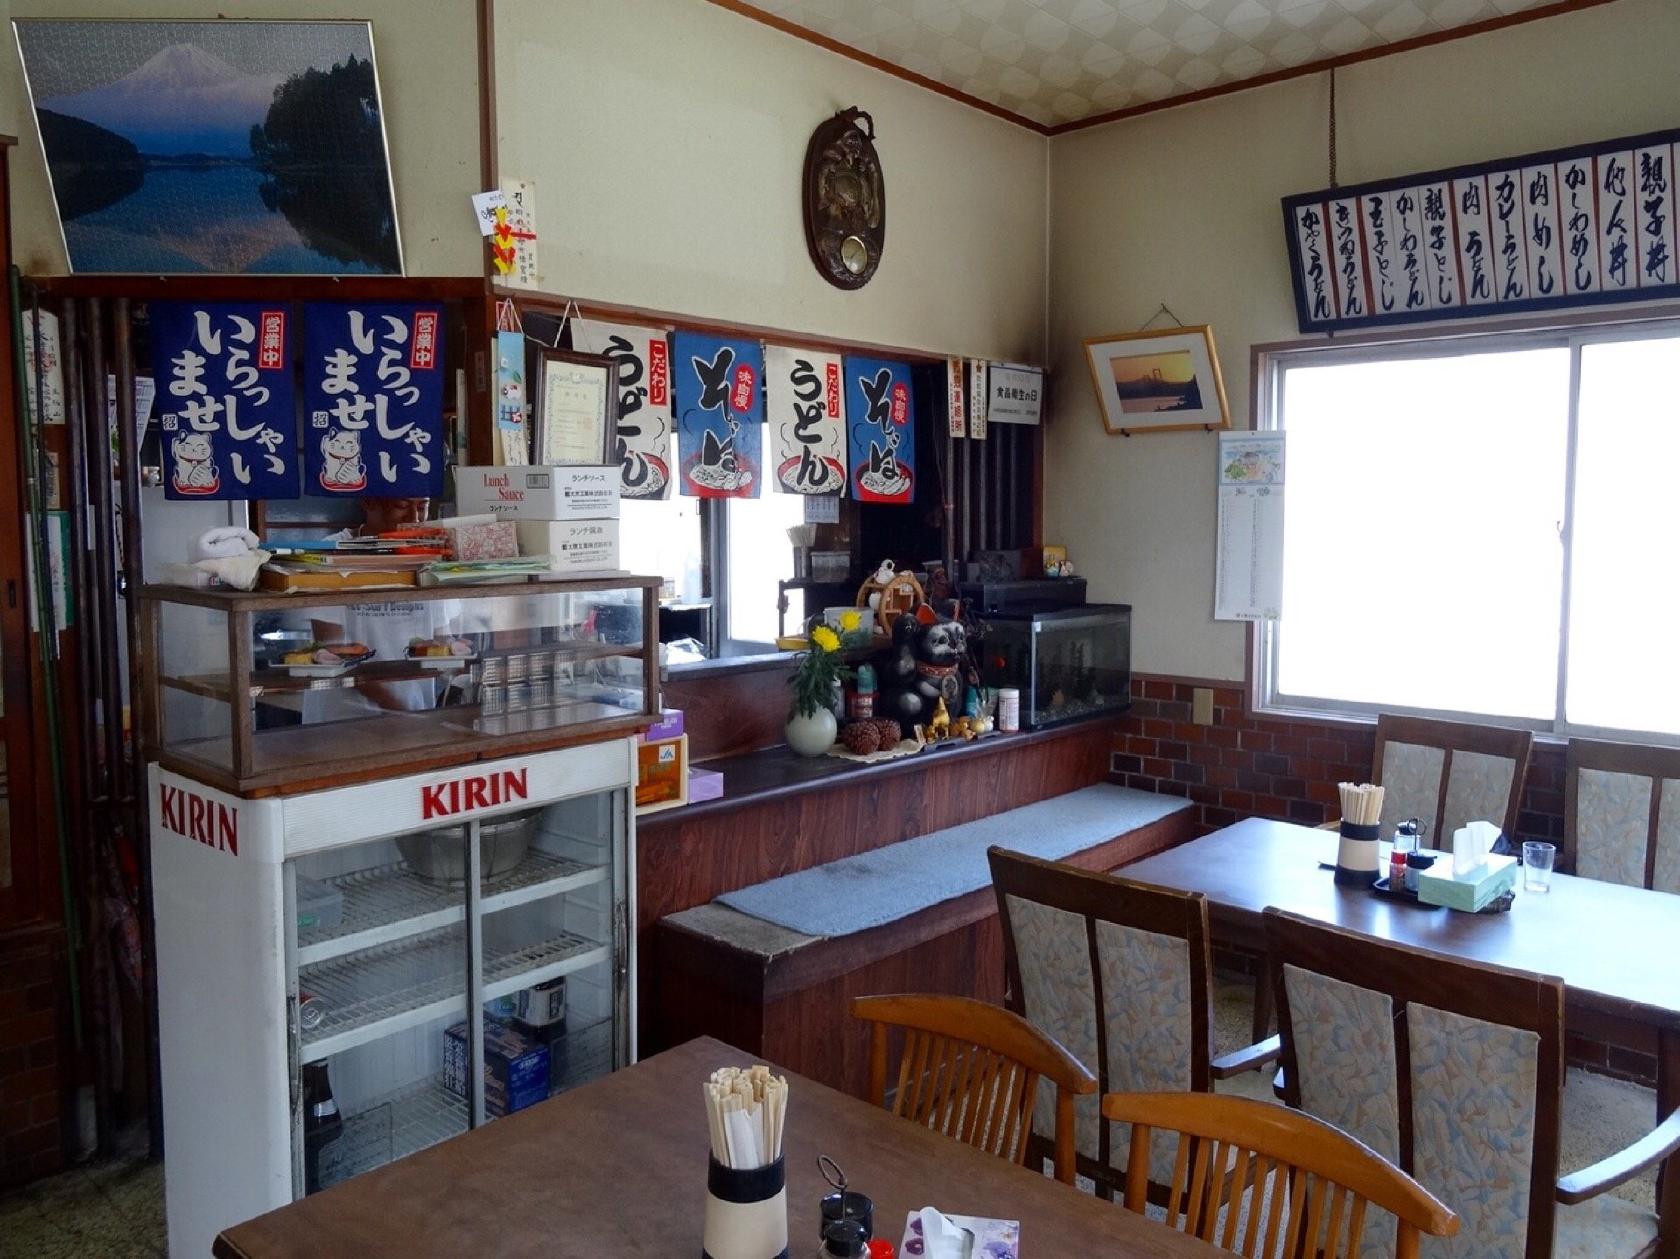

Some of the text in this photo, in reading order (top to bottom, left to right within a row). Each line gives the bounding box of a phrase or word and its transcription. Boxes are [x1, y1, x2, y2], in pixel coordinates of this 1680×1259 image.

[1424, 188, 1453, 304] 親子とじ
[1462, 181, 1490, 299] 肉うどん
[1641, 152, 1669, 283] 親子丼
[1335, 202, 1362, 315] きつねうどん
[263, 315, 282, 367] 営業中
[415, 315, 434, 367] 営業中
[651, 343, 666, 403] こだわり
[691, 346, 741, 475] そば
[790, 359, 829, 487] うどん
[827, 365, 839, 416] こだわり
[858, 368, 900, 481] そば
[483, 473, 510, 487] Lunch
[498, 487, 525, 500] Sauce
[160, 782, 238, 857] KIRIN
[421, 767, 528, 820] KIRIN
